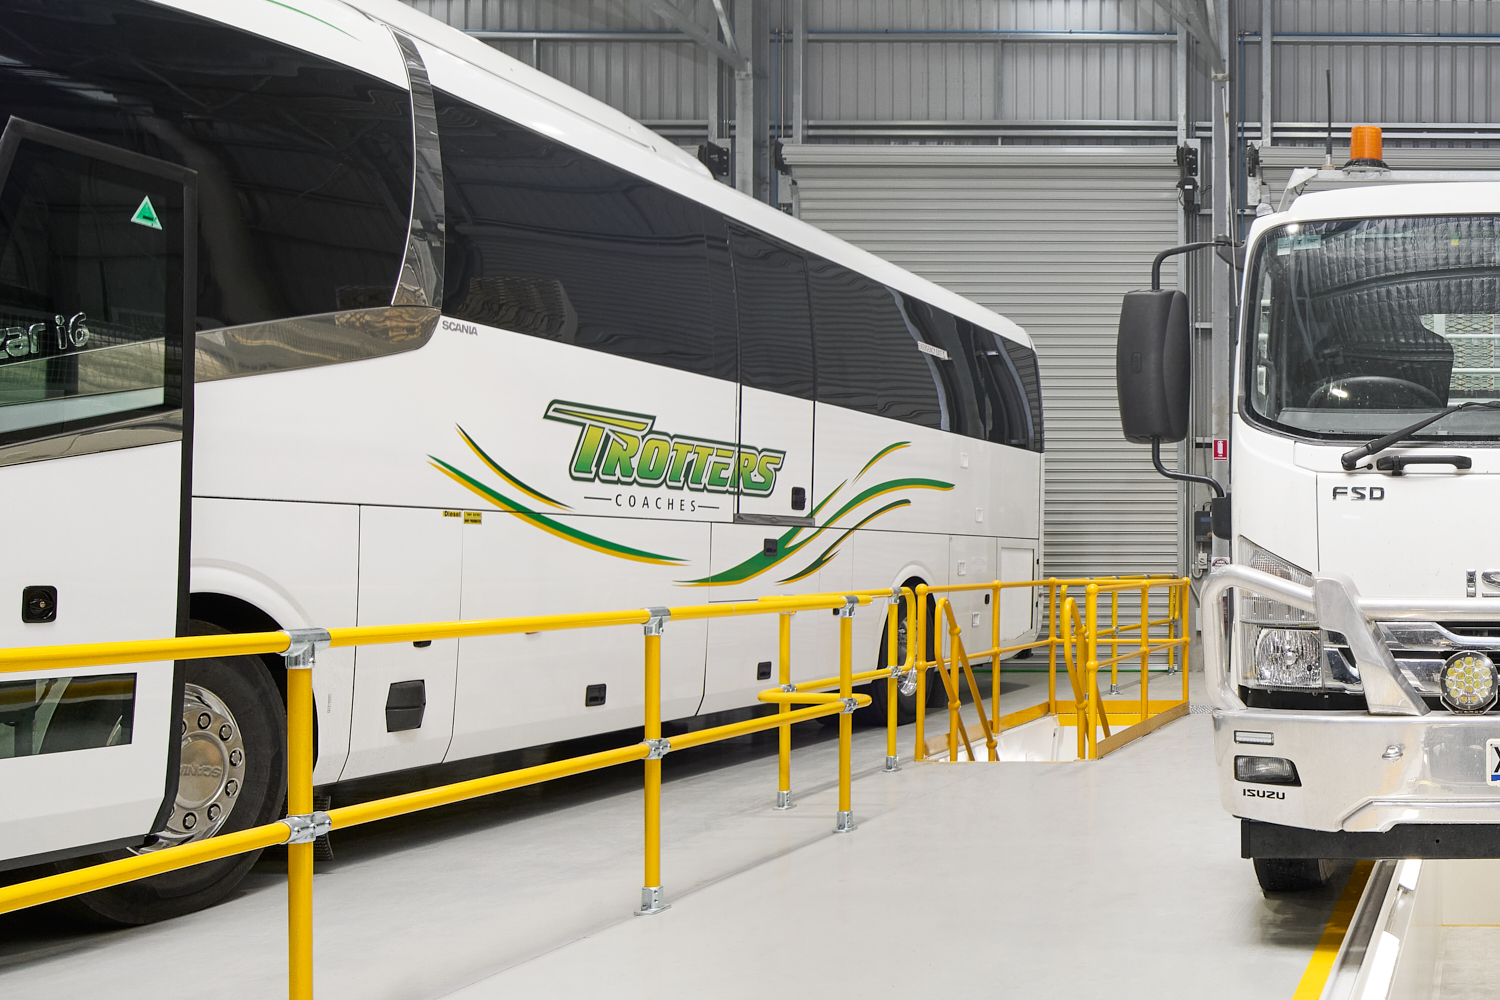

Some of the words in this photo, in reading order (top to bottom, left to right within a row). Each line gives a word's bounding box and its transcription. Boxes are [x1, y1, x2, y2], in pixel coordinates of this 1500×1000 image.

[55, 311, 89, 350] i6
[442, 320, 478, 336] SCANIA
[543, 399, 786, 498] TROTTERS
[1332, 486, 1385, 500] FSD
[615, 494, 696, 512] COACHES
[1242, 788, 1285, 800] ISUZU
